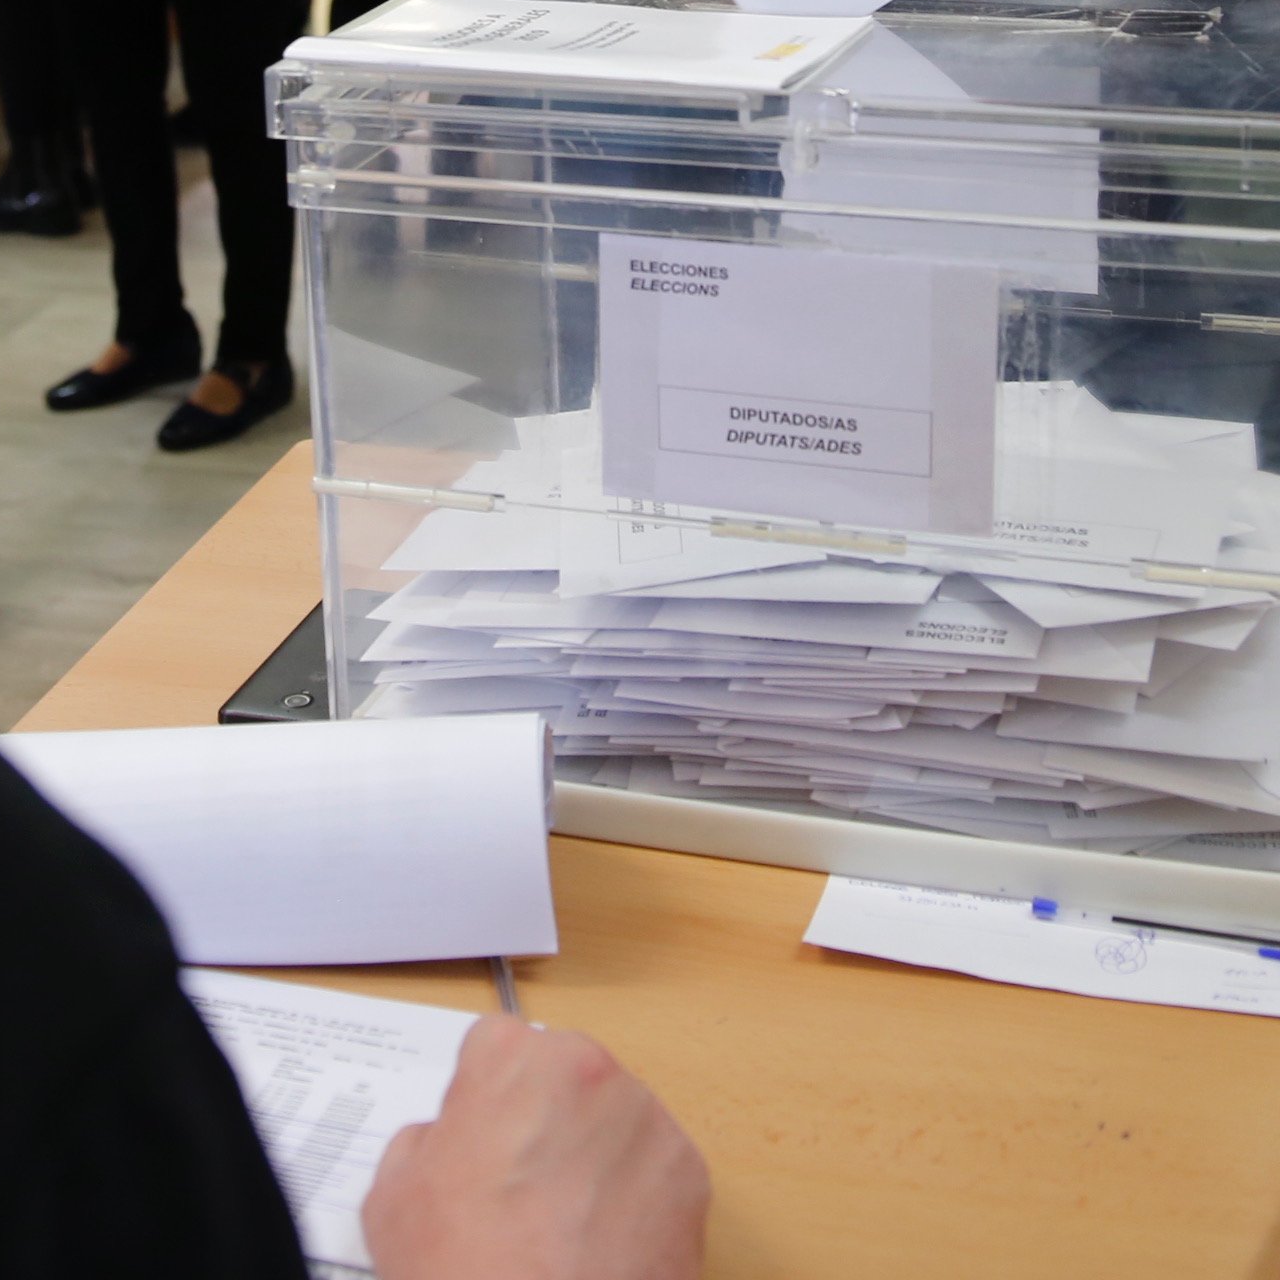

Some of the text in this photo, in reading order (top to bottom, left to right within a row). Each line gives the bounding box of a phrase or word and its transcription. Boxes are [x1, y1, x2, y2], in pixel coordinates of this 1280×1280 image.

[629, 259, 729, 281] ELECCIONES
[630, 277, 720, 298] ELECCIONS
[729, 406, 858, 433] DIPUTADOS/AS
[726, 429, 863, 456] DIPUTATS/ADES
[904, 630, 1007, 645] ELECCIONES
[918, 621, 1009, 636] ELECCIONS
